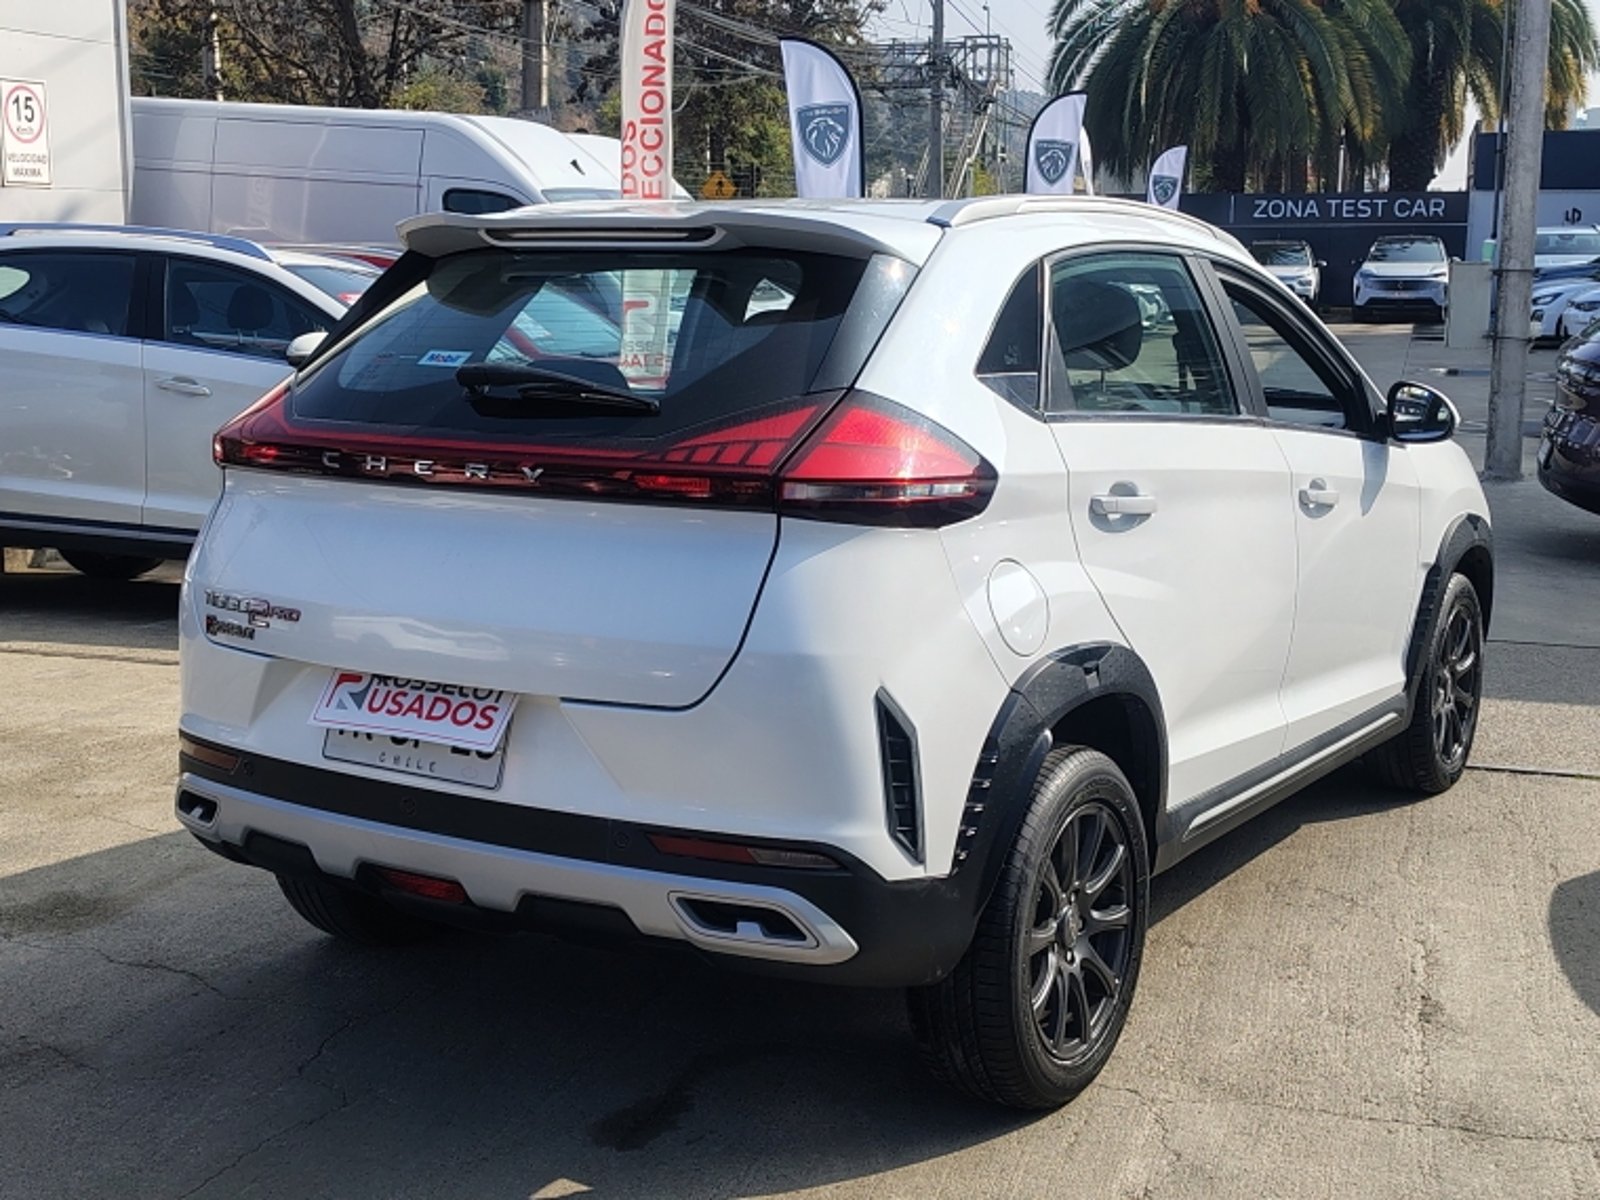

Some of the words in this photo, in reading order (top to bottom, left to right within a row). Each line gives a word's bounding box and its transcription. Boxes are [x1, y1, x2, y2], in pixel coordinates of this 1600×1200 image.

[12, 94, 35, 123] 15
[1252, 199, 1320, 218] ZONA
[1326, 199, 1388, 218] TEST
[1393, 199, 1446, 218] CAR
[321, 451, 544, 483] CHERY
[366, 687, 500, 731] USADOS
[377, 751, 437, 773] CHILE
